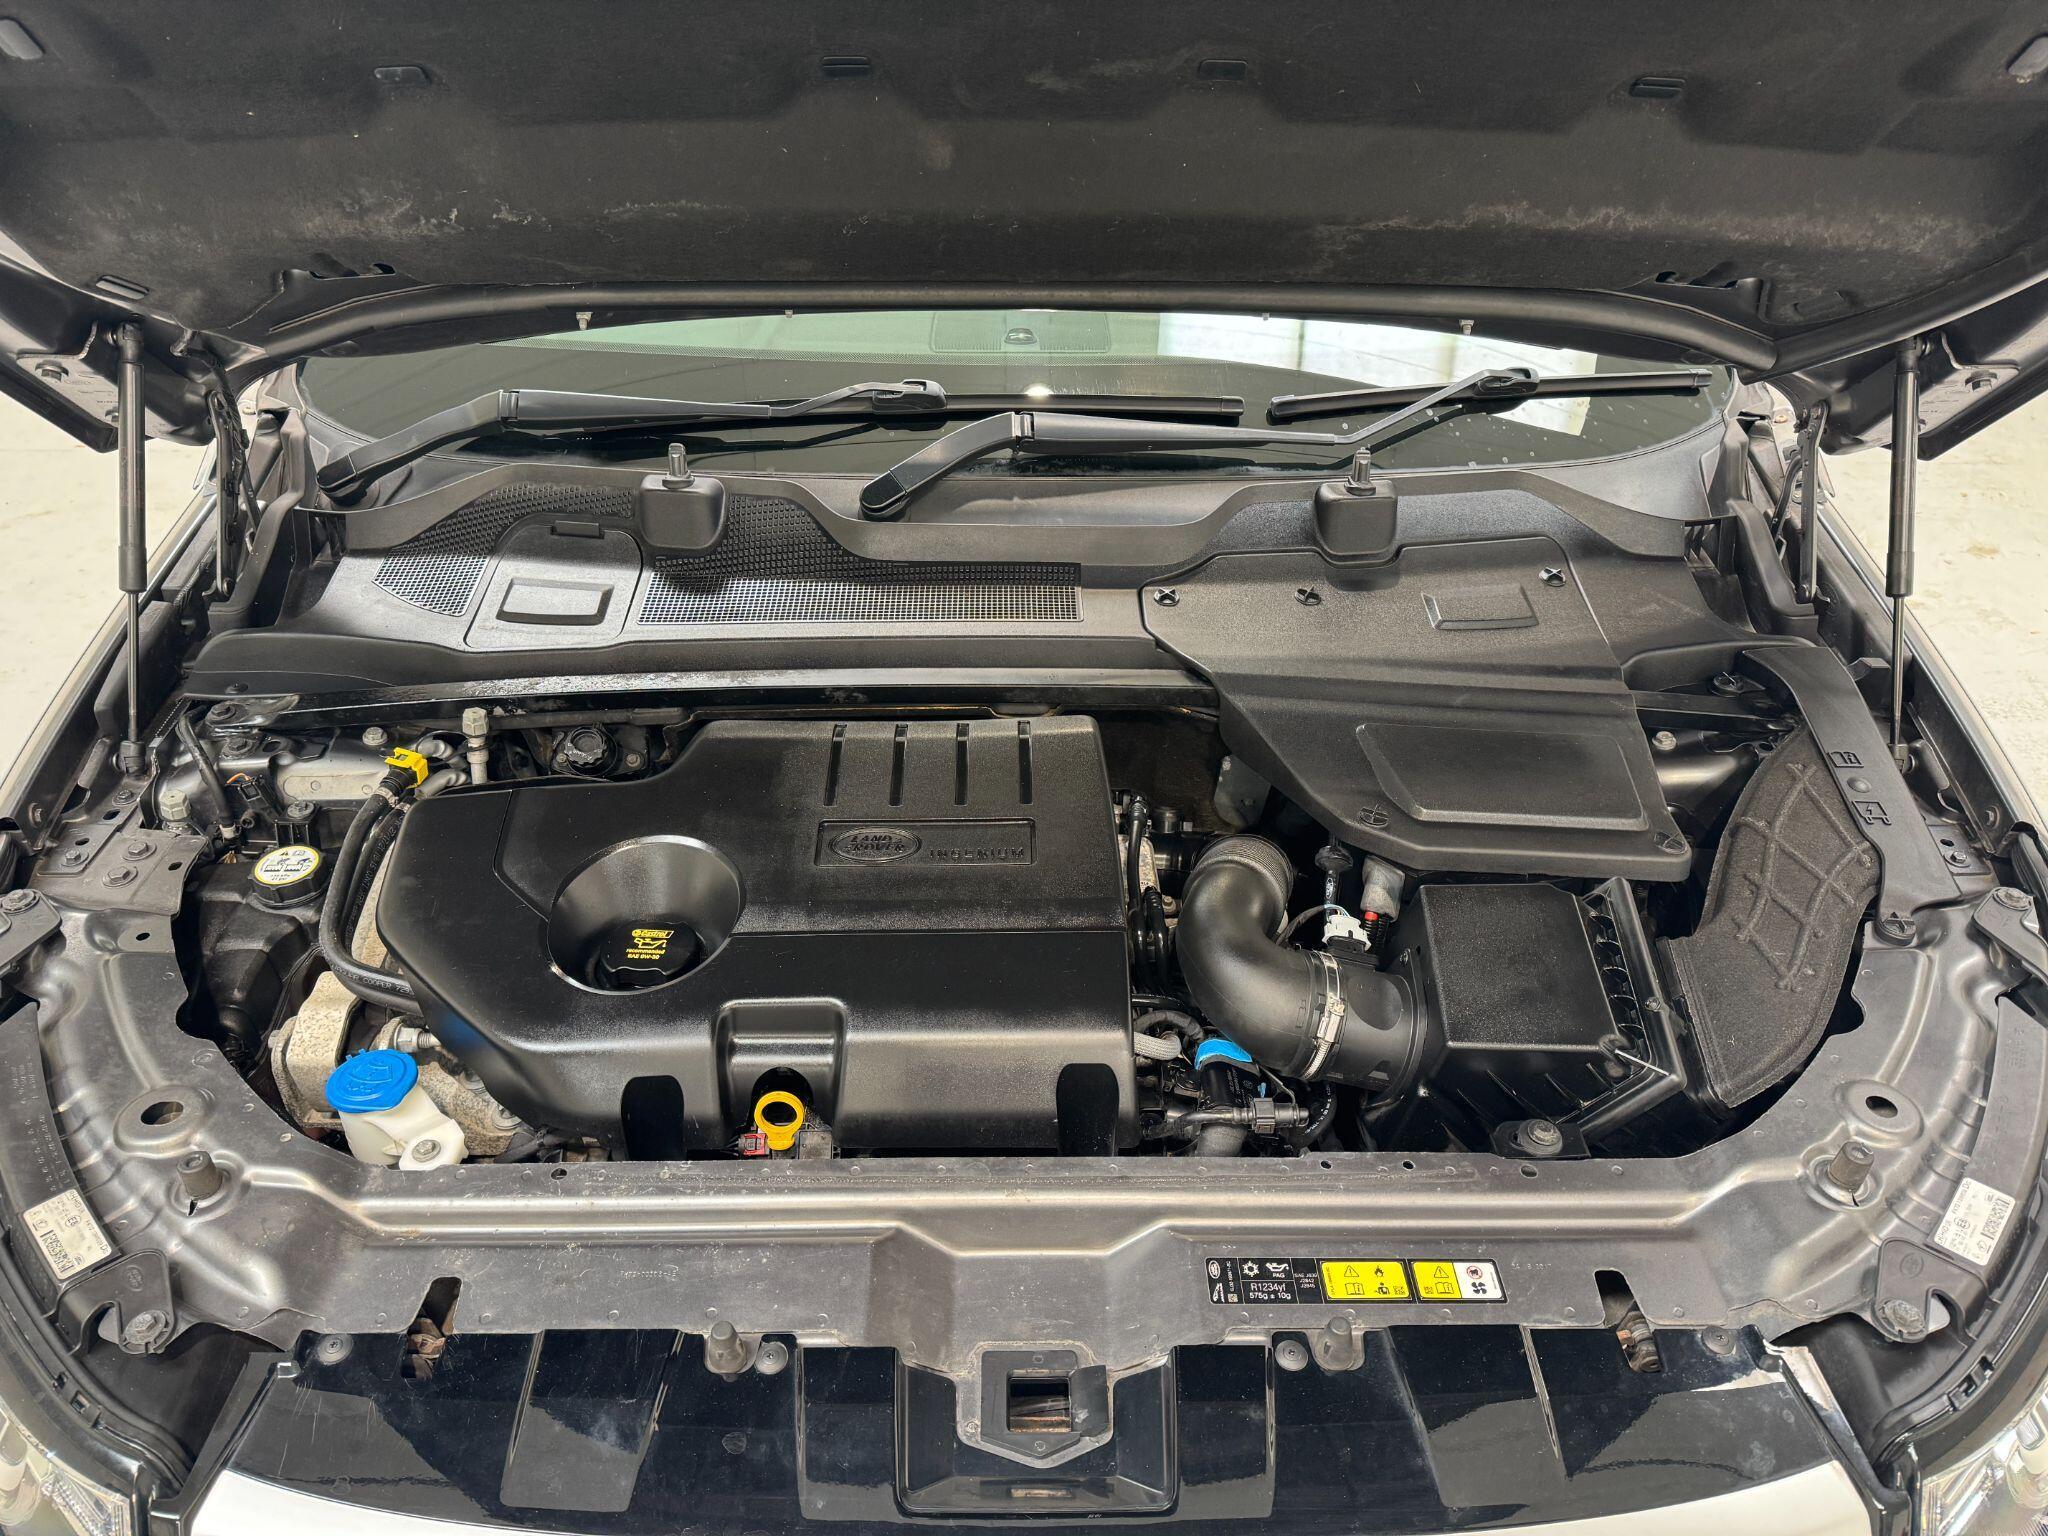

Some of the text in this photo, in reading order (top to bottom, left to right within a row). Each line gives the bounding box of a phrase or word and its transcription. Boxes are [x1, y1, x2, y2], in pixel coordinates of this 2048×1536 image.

[851, 834, 894, 843] LAND
[851, 842, 905, 853] ROVER
[929, 848, 1026, 860] INGENIUM
[362, 977, 392, 989] COOPER
[1250, 1282, 1287, 1292] R1234yf
[1249, 1292, 1268, 1300] 575g
[1277, 1292, 1292, 1300] 10g
